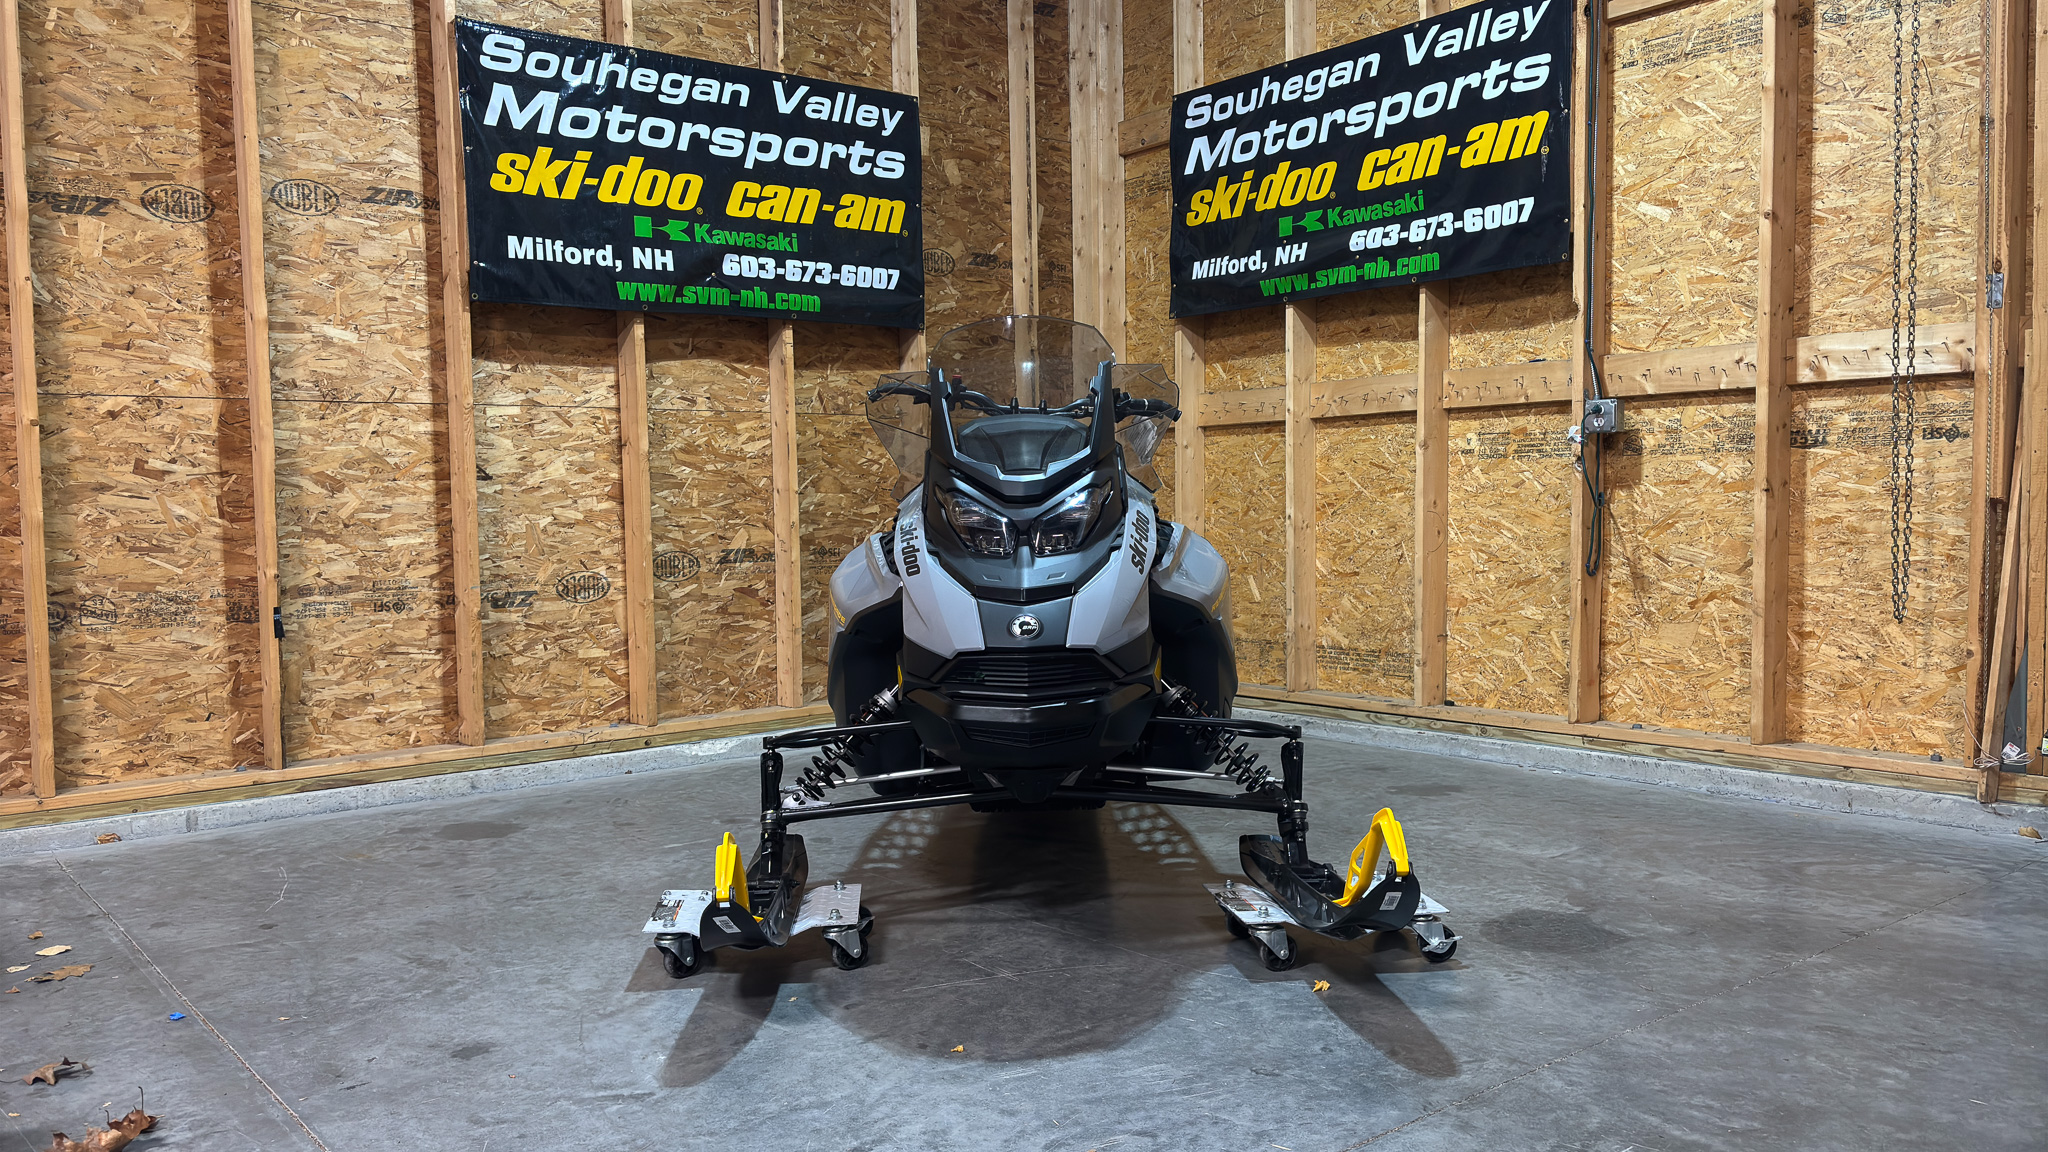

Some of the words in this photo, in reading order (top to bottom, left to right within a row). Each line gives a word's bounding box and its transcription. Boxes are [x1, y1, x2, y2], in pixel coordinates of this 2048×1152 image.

[479, 33, 750, 107] Souhegan
[772, 80, 904, 136] Valley
[1184, 51, 1381, 130] Souhegan
[1403, 0, 1552, 67] Valley
[482, 82, 906, 179] Motorsports
[1184, 52, 1553, 176] Motorsports
[489, 146, 703, 212] ski-doo
[725, 180, 906, 235] can-am
[1185, 160, 1338, 228] ski-doo
[1356, 110, 1550, 192] can-am
[1326, 190, 1425, 229] Kawasaki
[1348, 197, 1536, 252] 603-673-6007
[507, 235, 623, 273] Milford,
[633, 247, 675, 272] NH
[694, 223, 799, 253] Kawasaki
[1191, 247, 1268, 281] Milford,
[1275, 242, 1308, 266] NH
[616, 279, 822, 314] www.svm-nh.com
[722, 253, 900, 291] 603-673-6007
[1259, 250, 1440, 297] www.svm-nh.com
[900, 523, 921, 578] ski-doo
[1128, 509, 1151, 576] ski-doo
